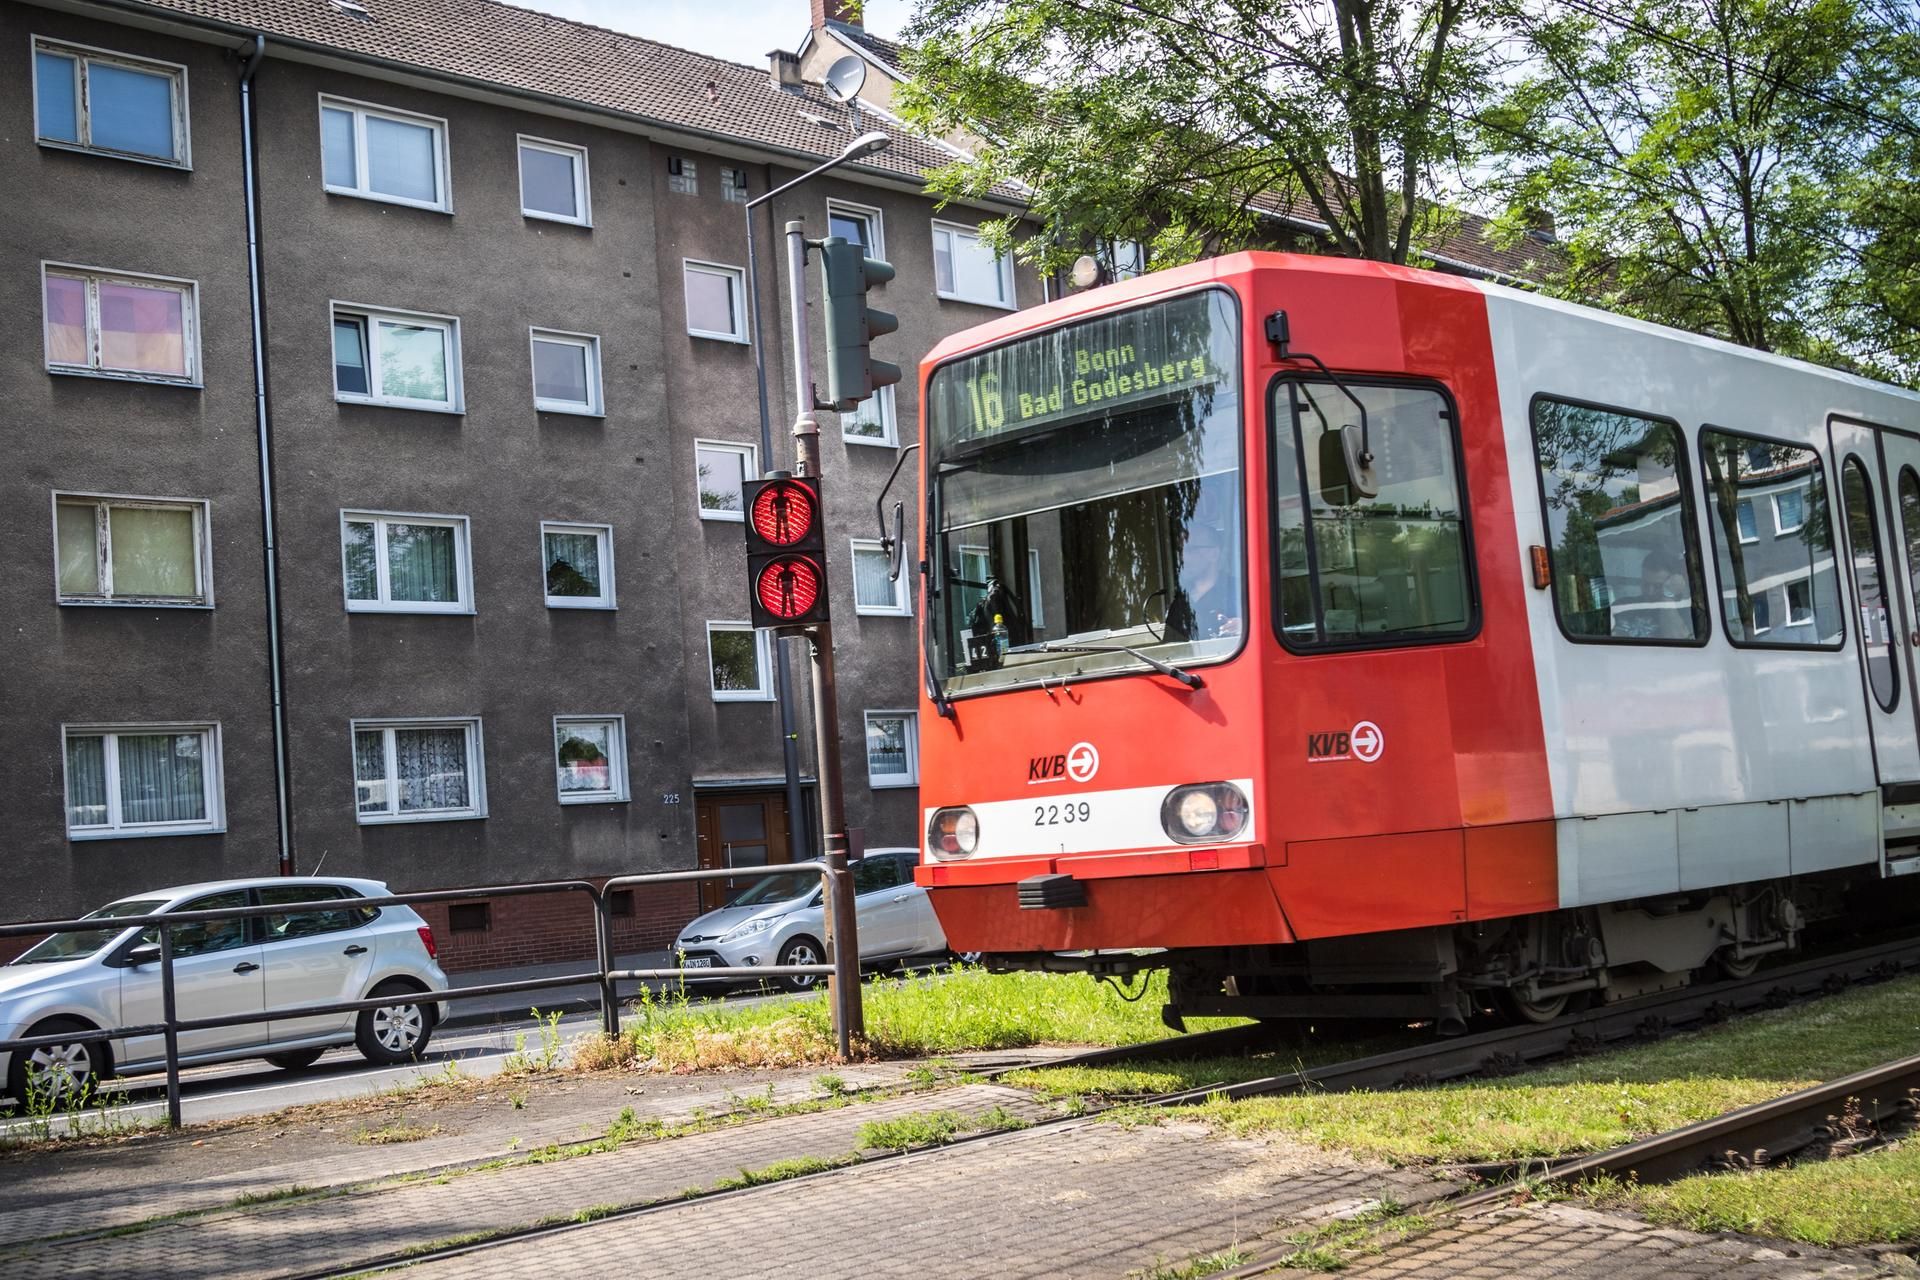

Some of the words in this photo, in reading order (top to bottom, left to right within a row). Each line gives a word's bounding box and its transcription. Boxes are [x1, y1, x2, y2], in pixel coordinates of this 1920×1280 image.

[1075, 344, 1135, 375] Bonn
[1019, 385, 1061, 418] Bad
[1072, 356, 1205, 405] Godesberg
[967, 372, 1004, 431] 16
[1308, 732, 1350, 757] KVB
[1029, 755, 1065, 780] KVB
[663, 793, 680, 804] 225
[1034, 801, 1090, 826] 2239
